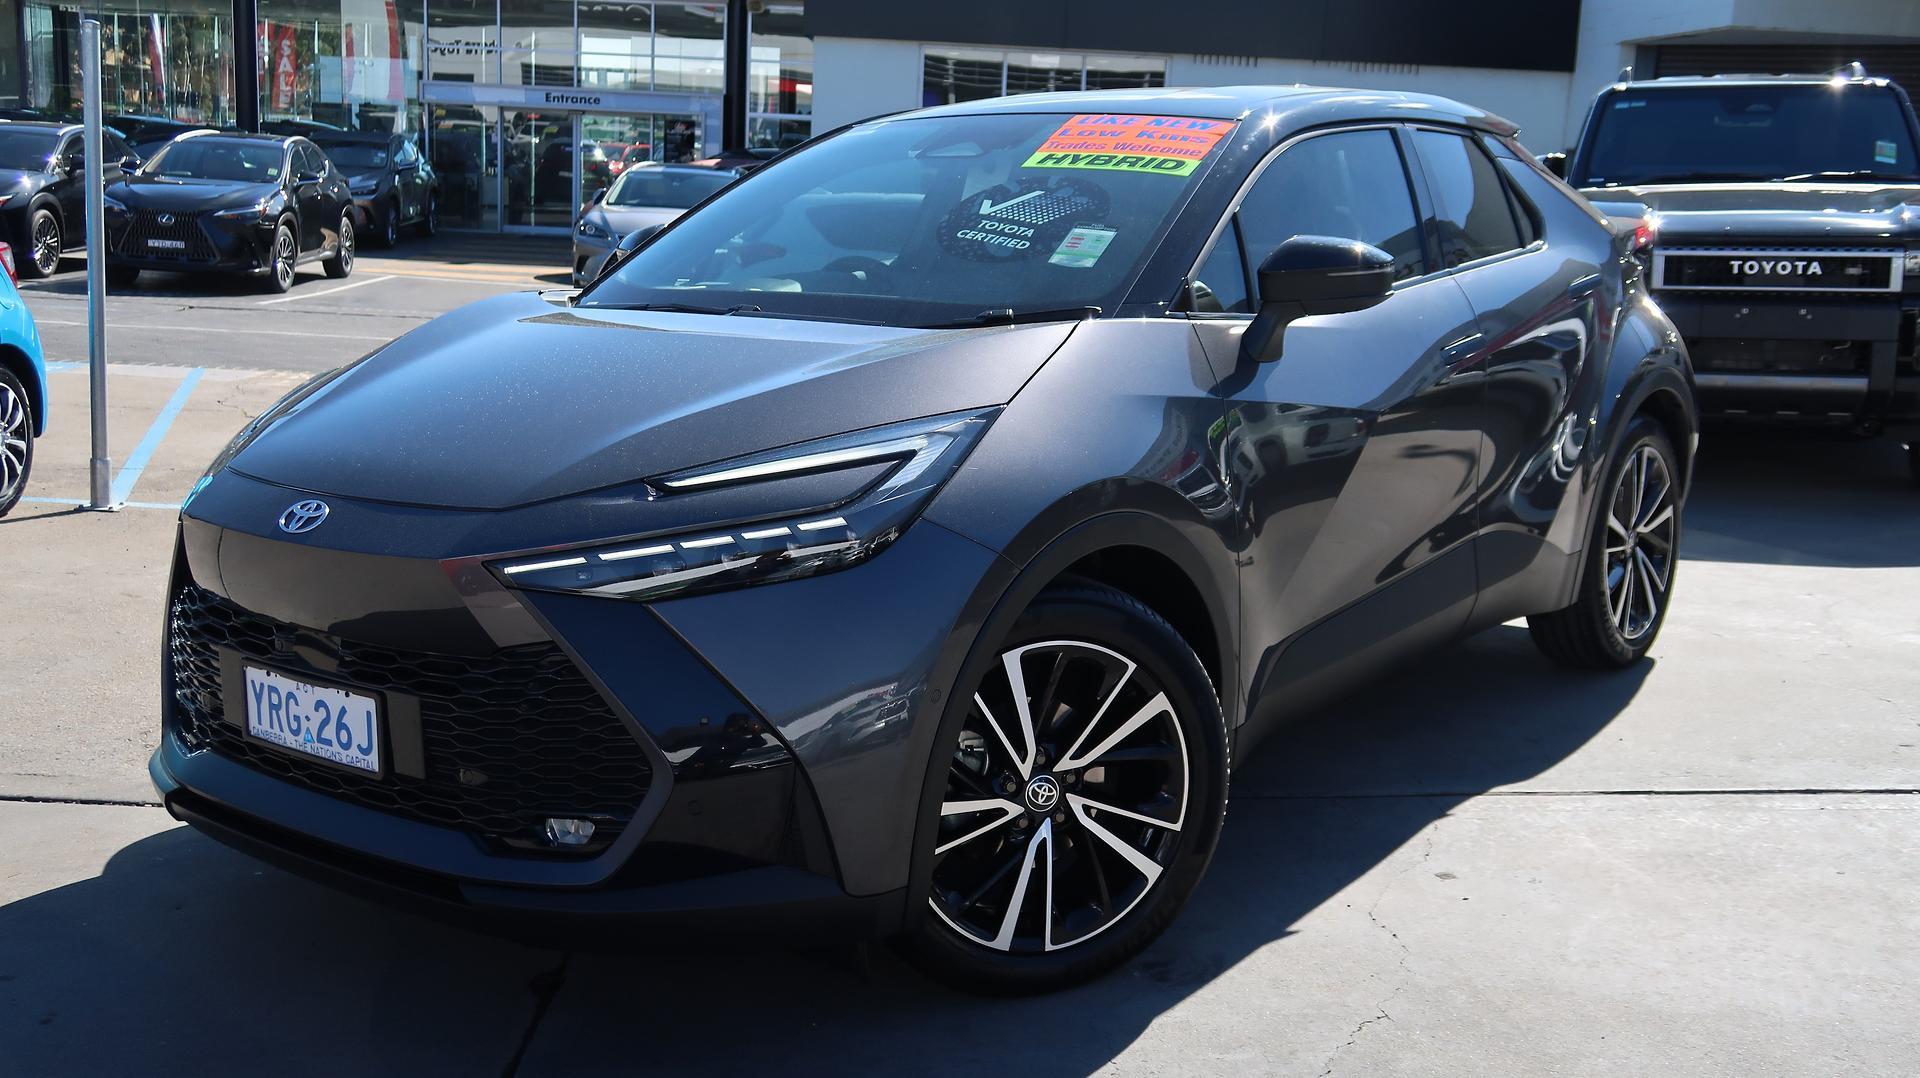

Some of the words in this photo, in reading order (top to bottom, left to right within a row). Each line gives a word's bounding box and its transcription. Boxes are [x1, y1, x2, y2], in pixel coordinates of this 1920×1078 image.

[279, 39, 294, 107] SALE
[545, 92, 600, 105] Entrance
[1077, 115, 1141, 126] LIKE
[1146, 117, 1222, 131] NEW
[1058, 128, 1126, 138] Low
[1136, 130, 1210, 144] Kms
[1046, 140, 1107, 150] Trades
[1112, 142, 1202, 156] Welcome
[1036, 153, 1185, 171] HYBRID
[978, 220, 1035, 238] TOYOTA
[956, 229, 1031, 250] CERTIFIED
[1729, 260, 1823, 276] TOYOTA
[252, 726, 288, 745] CANBERRA
[294, 739, 308, 752] THE
[345, 754, 376, 771] CAPITAL
